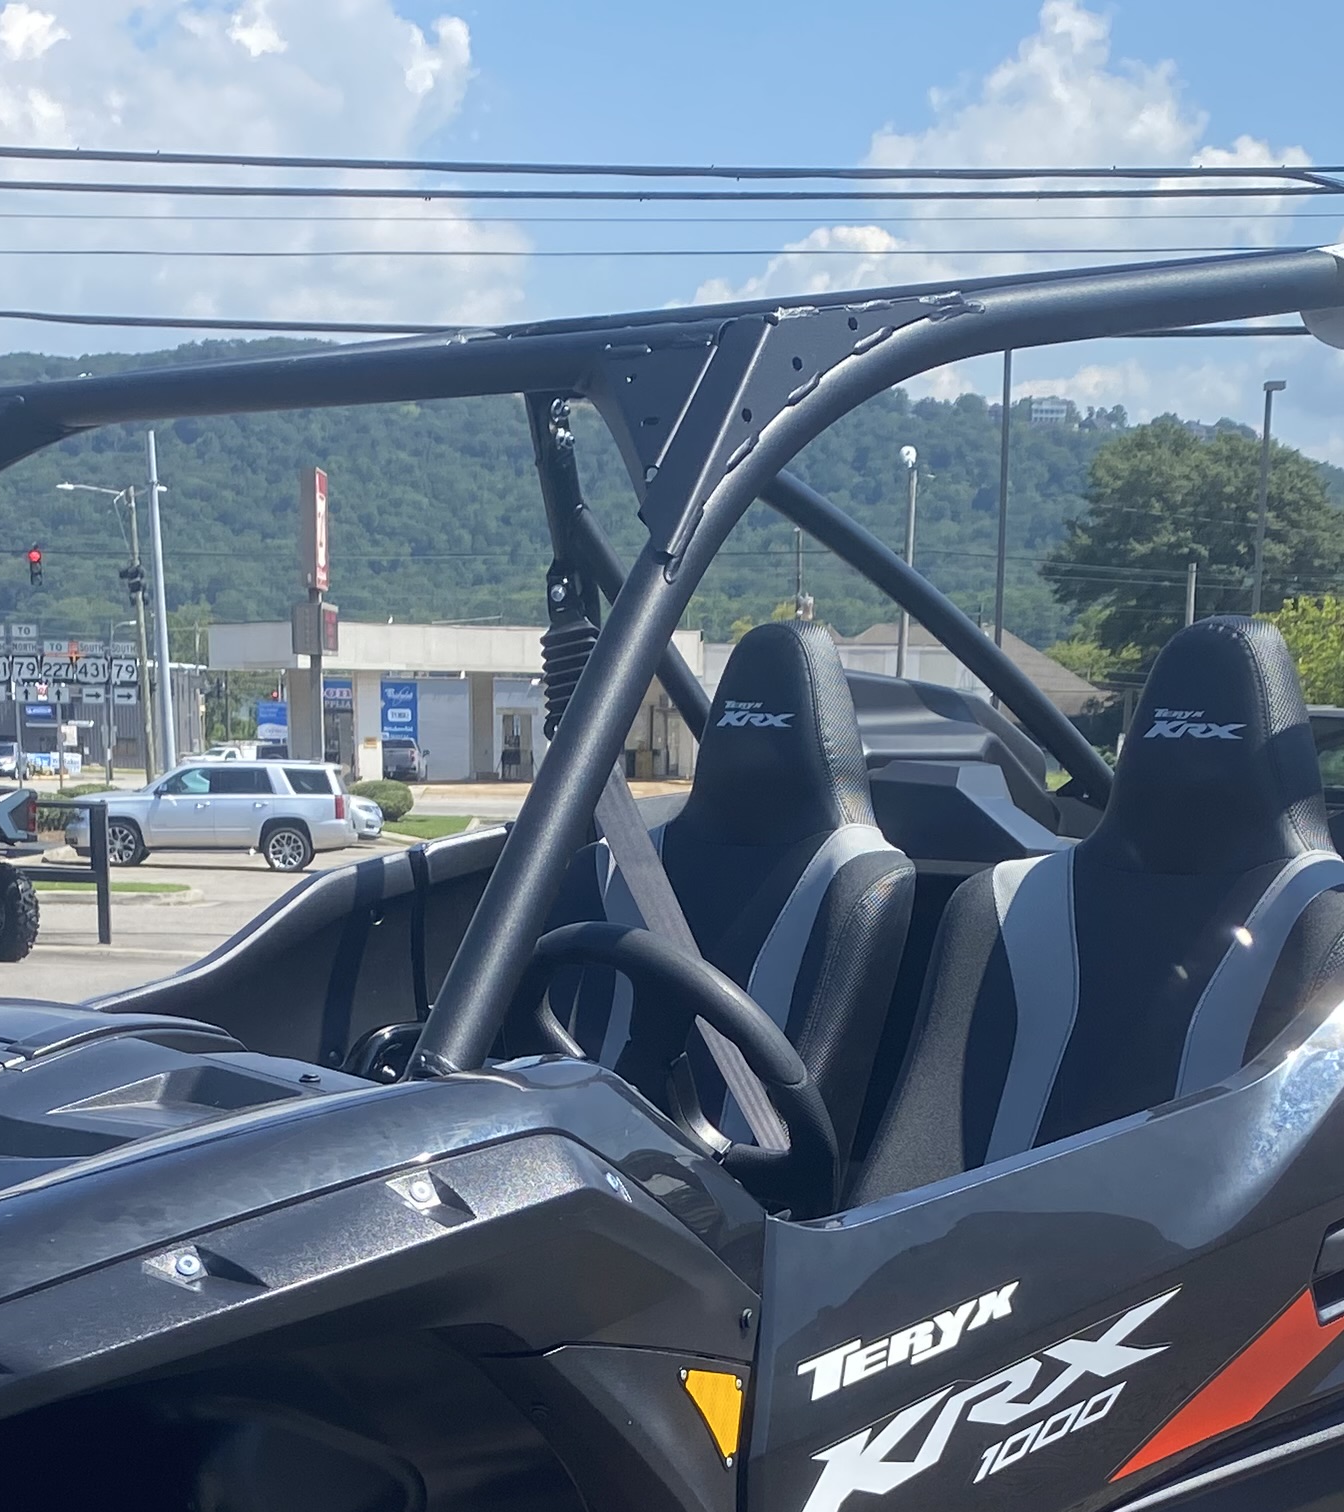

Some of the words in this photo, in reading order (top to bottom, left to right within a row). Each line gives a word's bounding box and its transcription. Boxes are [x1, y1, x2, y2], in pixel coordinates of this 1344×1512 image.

[17, 626, 31, 635] TO
[12, 642, 37, 651] NORTH
[49, 643, 63, 652] TO
[79, 643, 105, 652] SOUTH
[111, 643, 137, 652] SOUTH
[14, 662, 36, 677] 79
[43, 662, 71, 678] 227
[78, 662, 107, 679] 431
[113, 664, 135, 679] 79
[716, 711, 796, 728] KRX
[1143, 720, 1248, 739] KRX
[797, 1280, 1020, 1401] TERYX
[972, 1381, 1128, 1484] 1000
